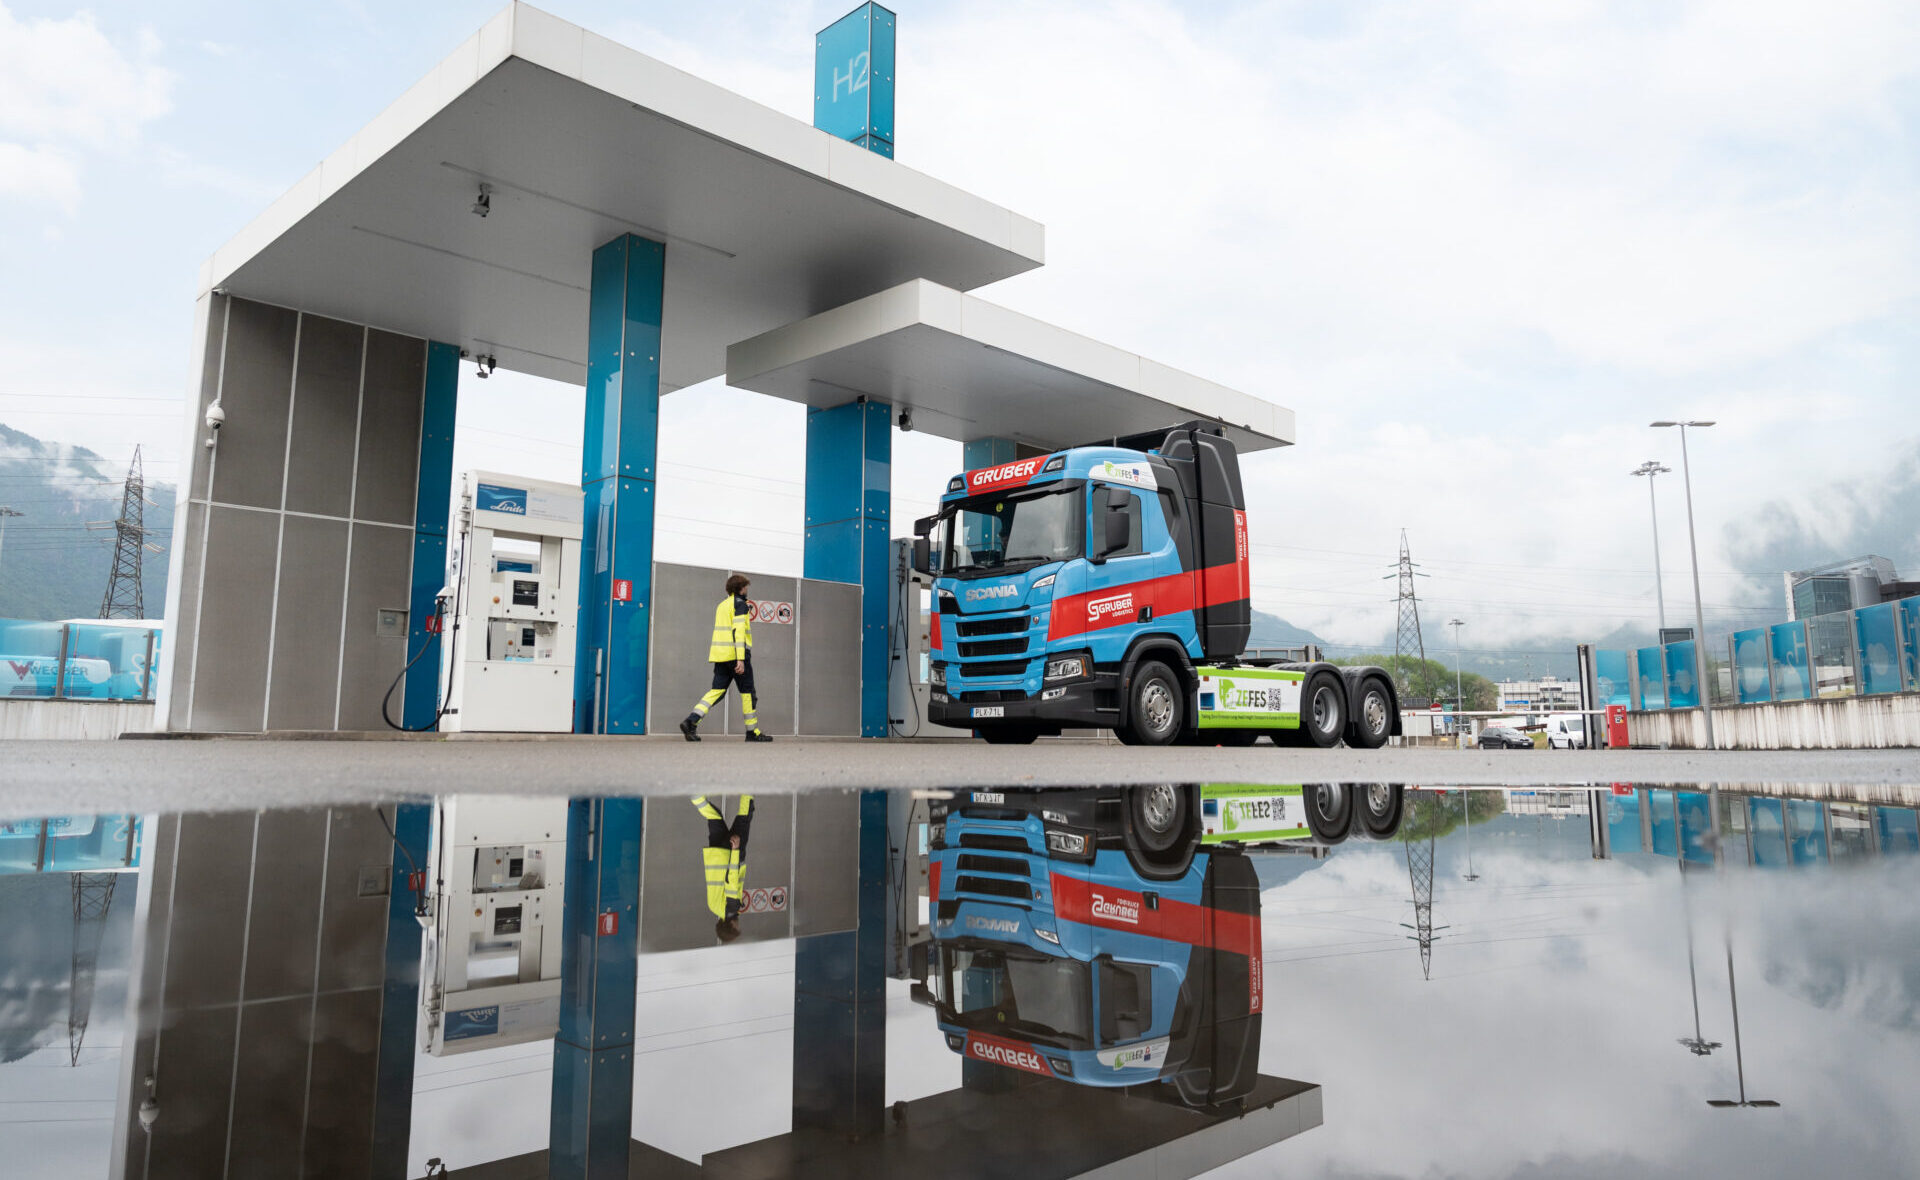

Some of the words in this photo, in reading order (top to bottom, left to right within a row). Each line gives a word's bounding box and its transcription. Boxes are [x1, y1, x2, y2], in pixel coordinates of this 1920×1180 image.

[832, 51, 869, 103] H2
[973, 461, 1036, 486] GRUBER
[490, 500, 525, 514] Linde
[966, 584, 1018, 602] SCANIA
[1099, 598, 1133, 614] GRUBER
[1235, 689, 1267, 708] ZEFES
